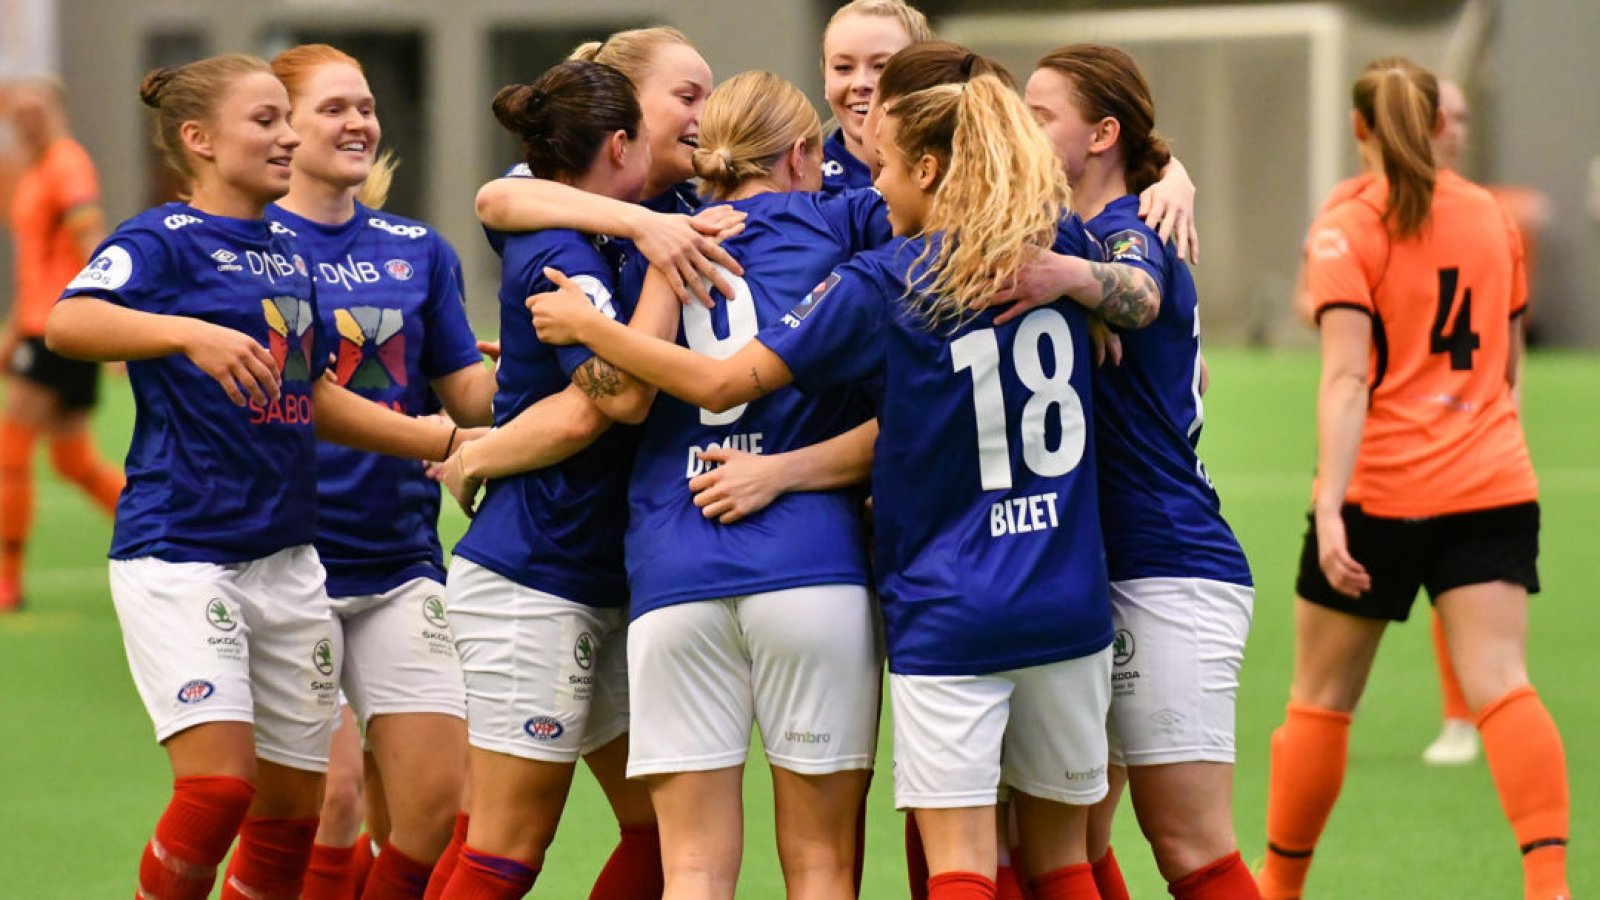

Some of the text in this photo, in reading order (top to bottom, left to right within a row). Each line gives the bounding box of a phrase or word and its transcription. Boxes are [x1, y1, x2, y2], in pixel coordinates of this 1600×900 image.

[246, 251, 294, 284] DNB
[319, 254, 380, 291] DNB
[1430, 266, 1480, 371] 4
[248, 394, 315, 425] SABO
[950, 307, 1087, 491] 18
[990, 492, 1059, 537] BIZET
[784, 730, 831, 744] umbro
